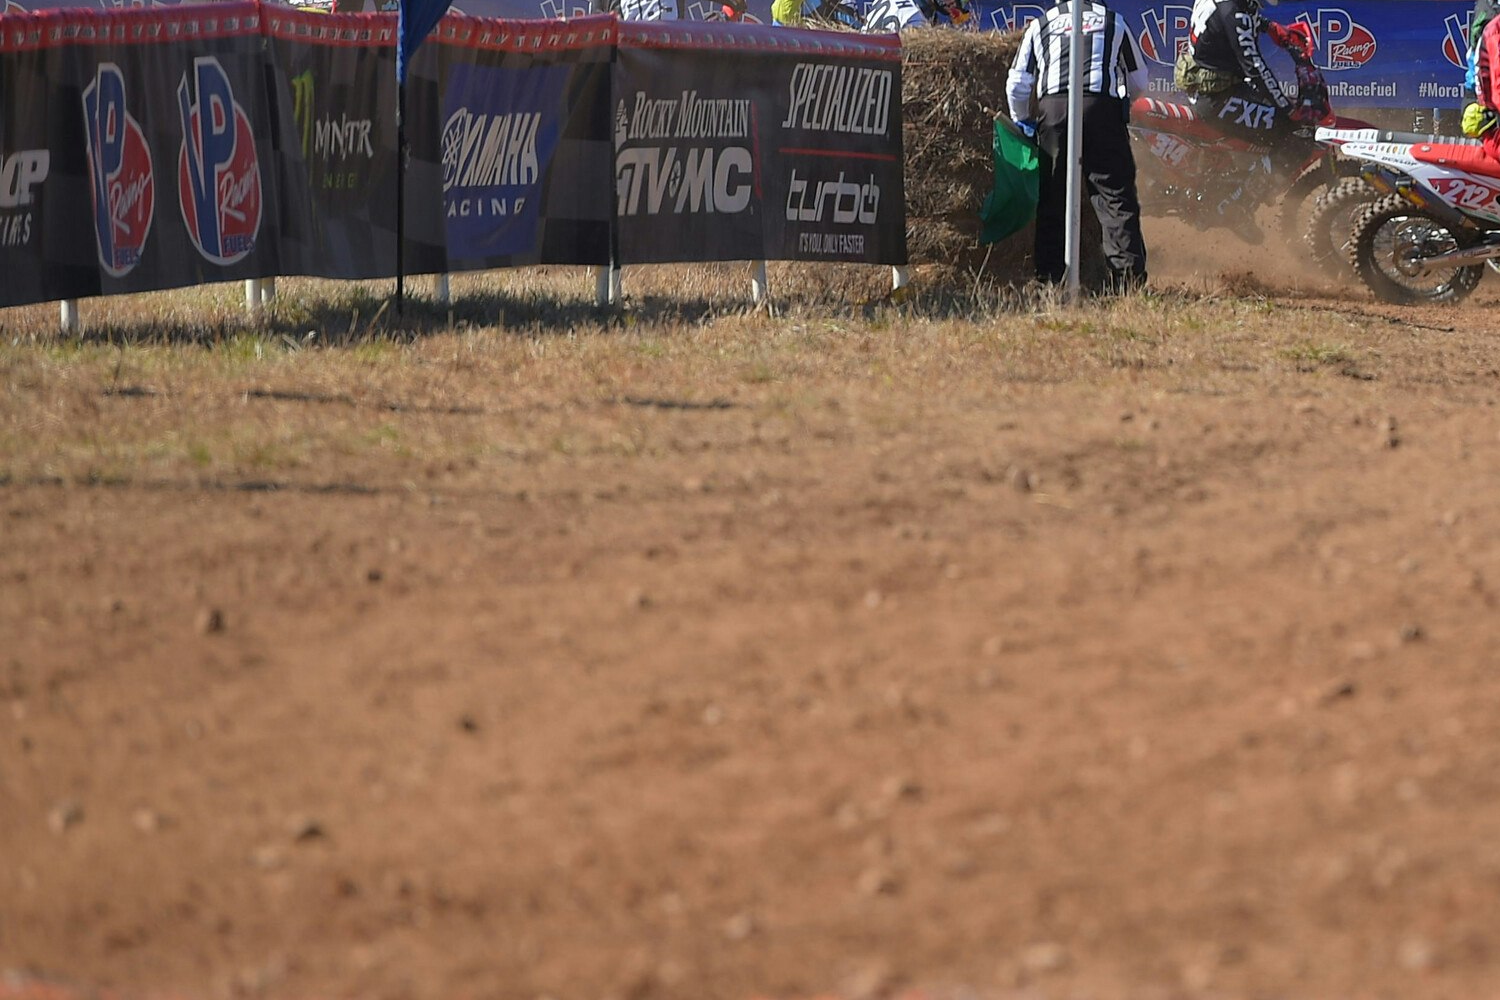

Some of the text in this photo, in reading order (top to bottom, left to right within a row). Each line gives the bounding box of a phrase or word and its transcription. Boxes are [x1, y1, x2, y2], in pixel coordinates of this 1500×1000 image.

[1235, 12, 1260, 57] FXR
[1330, 60, 1362, 68] FUELS
[1332, 41, 1375, 64] Racing
[629, 89, 751, 140] ROCKY MOUNTAIN
[781, 63, 893, 137] SPECIALIZED
[1217, 96, 1276, 130] FXR
[454, 111, 542, 188] YAMAHA
[1151, 132, 1189, 167] 314
[220, 158, 261, 234] Racing
[443, 198, 526, 217] ACING
[785, 168, 881, 225] turbo
[1448, 177, 1490, 207] 212
[223, 234, 256, 253] FUELS
[840, 234, 865, 255] FASTER
